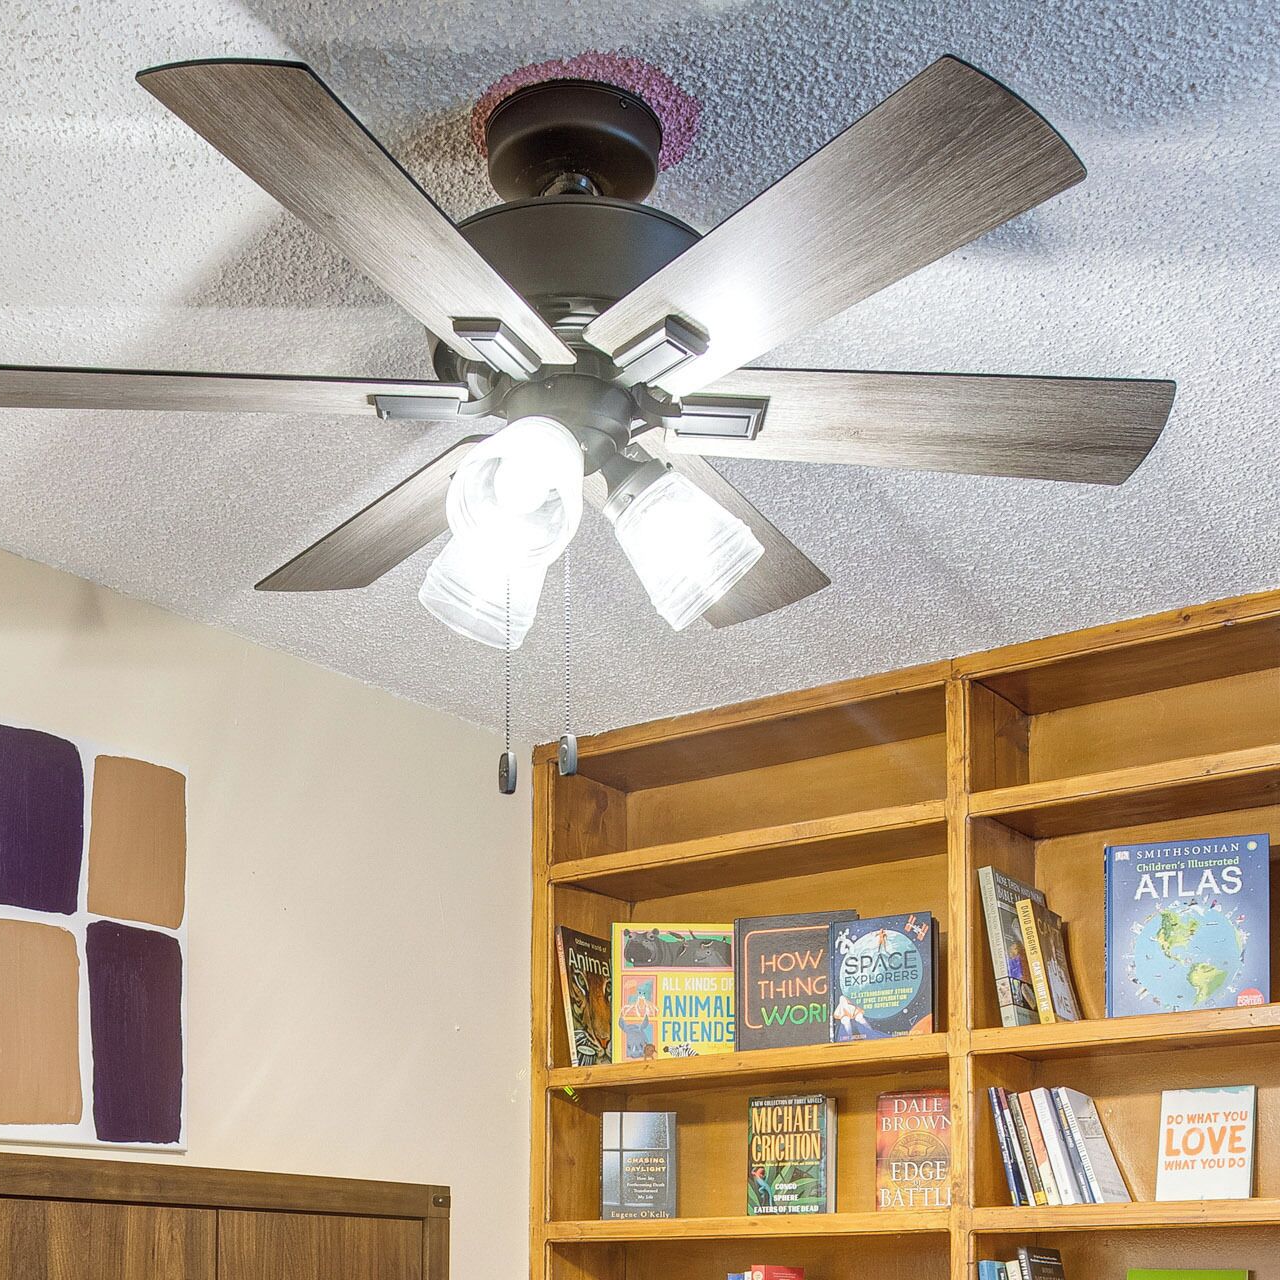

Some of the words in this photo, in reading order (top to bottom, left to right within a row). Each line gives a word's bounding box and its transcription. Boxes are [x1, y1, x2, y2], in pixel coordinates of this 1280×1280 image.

[1137, 843, 1240, 859] SMITHSONIAN
[1136, 861, 1185, 873] Children's
[1188, 856, 1240, 868] Illustrated
[1134, 866, 1243, 900] ATLAS
[1020, 905, 1031, 925] DAVID
[1025, 927, 1038, 955] GOGGINS
[568, 947, 610, 977] Anima
[761, 949, 824, 974] HOW
[845, 950, 917, 976] SPACE
[662, 977, 681, 991] ALL
[684, 976, 718, 991] KINDS
[758, 975, 827, 1000] THING
[844, 969, 919, 987] EXPLORERS
[662, 995, 735, 1018] ANIMAL
[662, 1021, 735, 1043] FRIENDS
[894, 1097, 943, 1114] DALE
[752, 1104, 820, 1134] MICHAEL
[1166, 1114, 1183, 1125] DO
[1187, 1112, 1219, 1124] WHAT
[1223, 1110, 1249, 1122] YOU
[751, 1133, 821, 1162] CRICHTON
[1165, 1125, 1246, 1157] LOVE
[890, 1160, 946, 1181] EDGE
[1164, 1159, 1197, 1171] WHAT
[1200, 1158, 1225, 1170] YOU
[1228, 1157, 1246, 1168] DO
[611, 1211, 637, 1219] Eugene
[640, 1210, 670, 1219] O'Kelly
[788, 1205, 800, 1213] THE
[801, 1204, 819, 1212] DEAD
[1019, 1254, 1030, 1280] DIVINE
